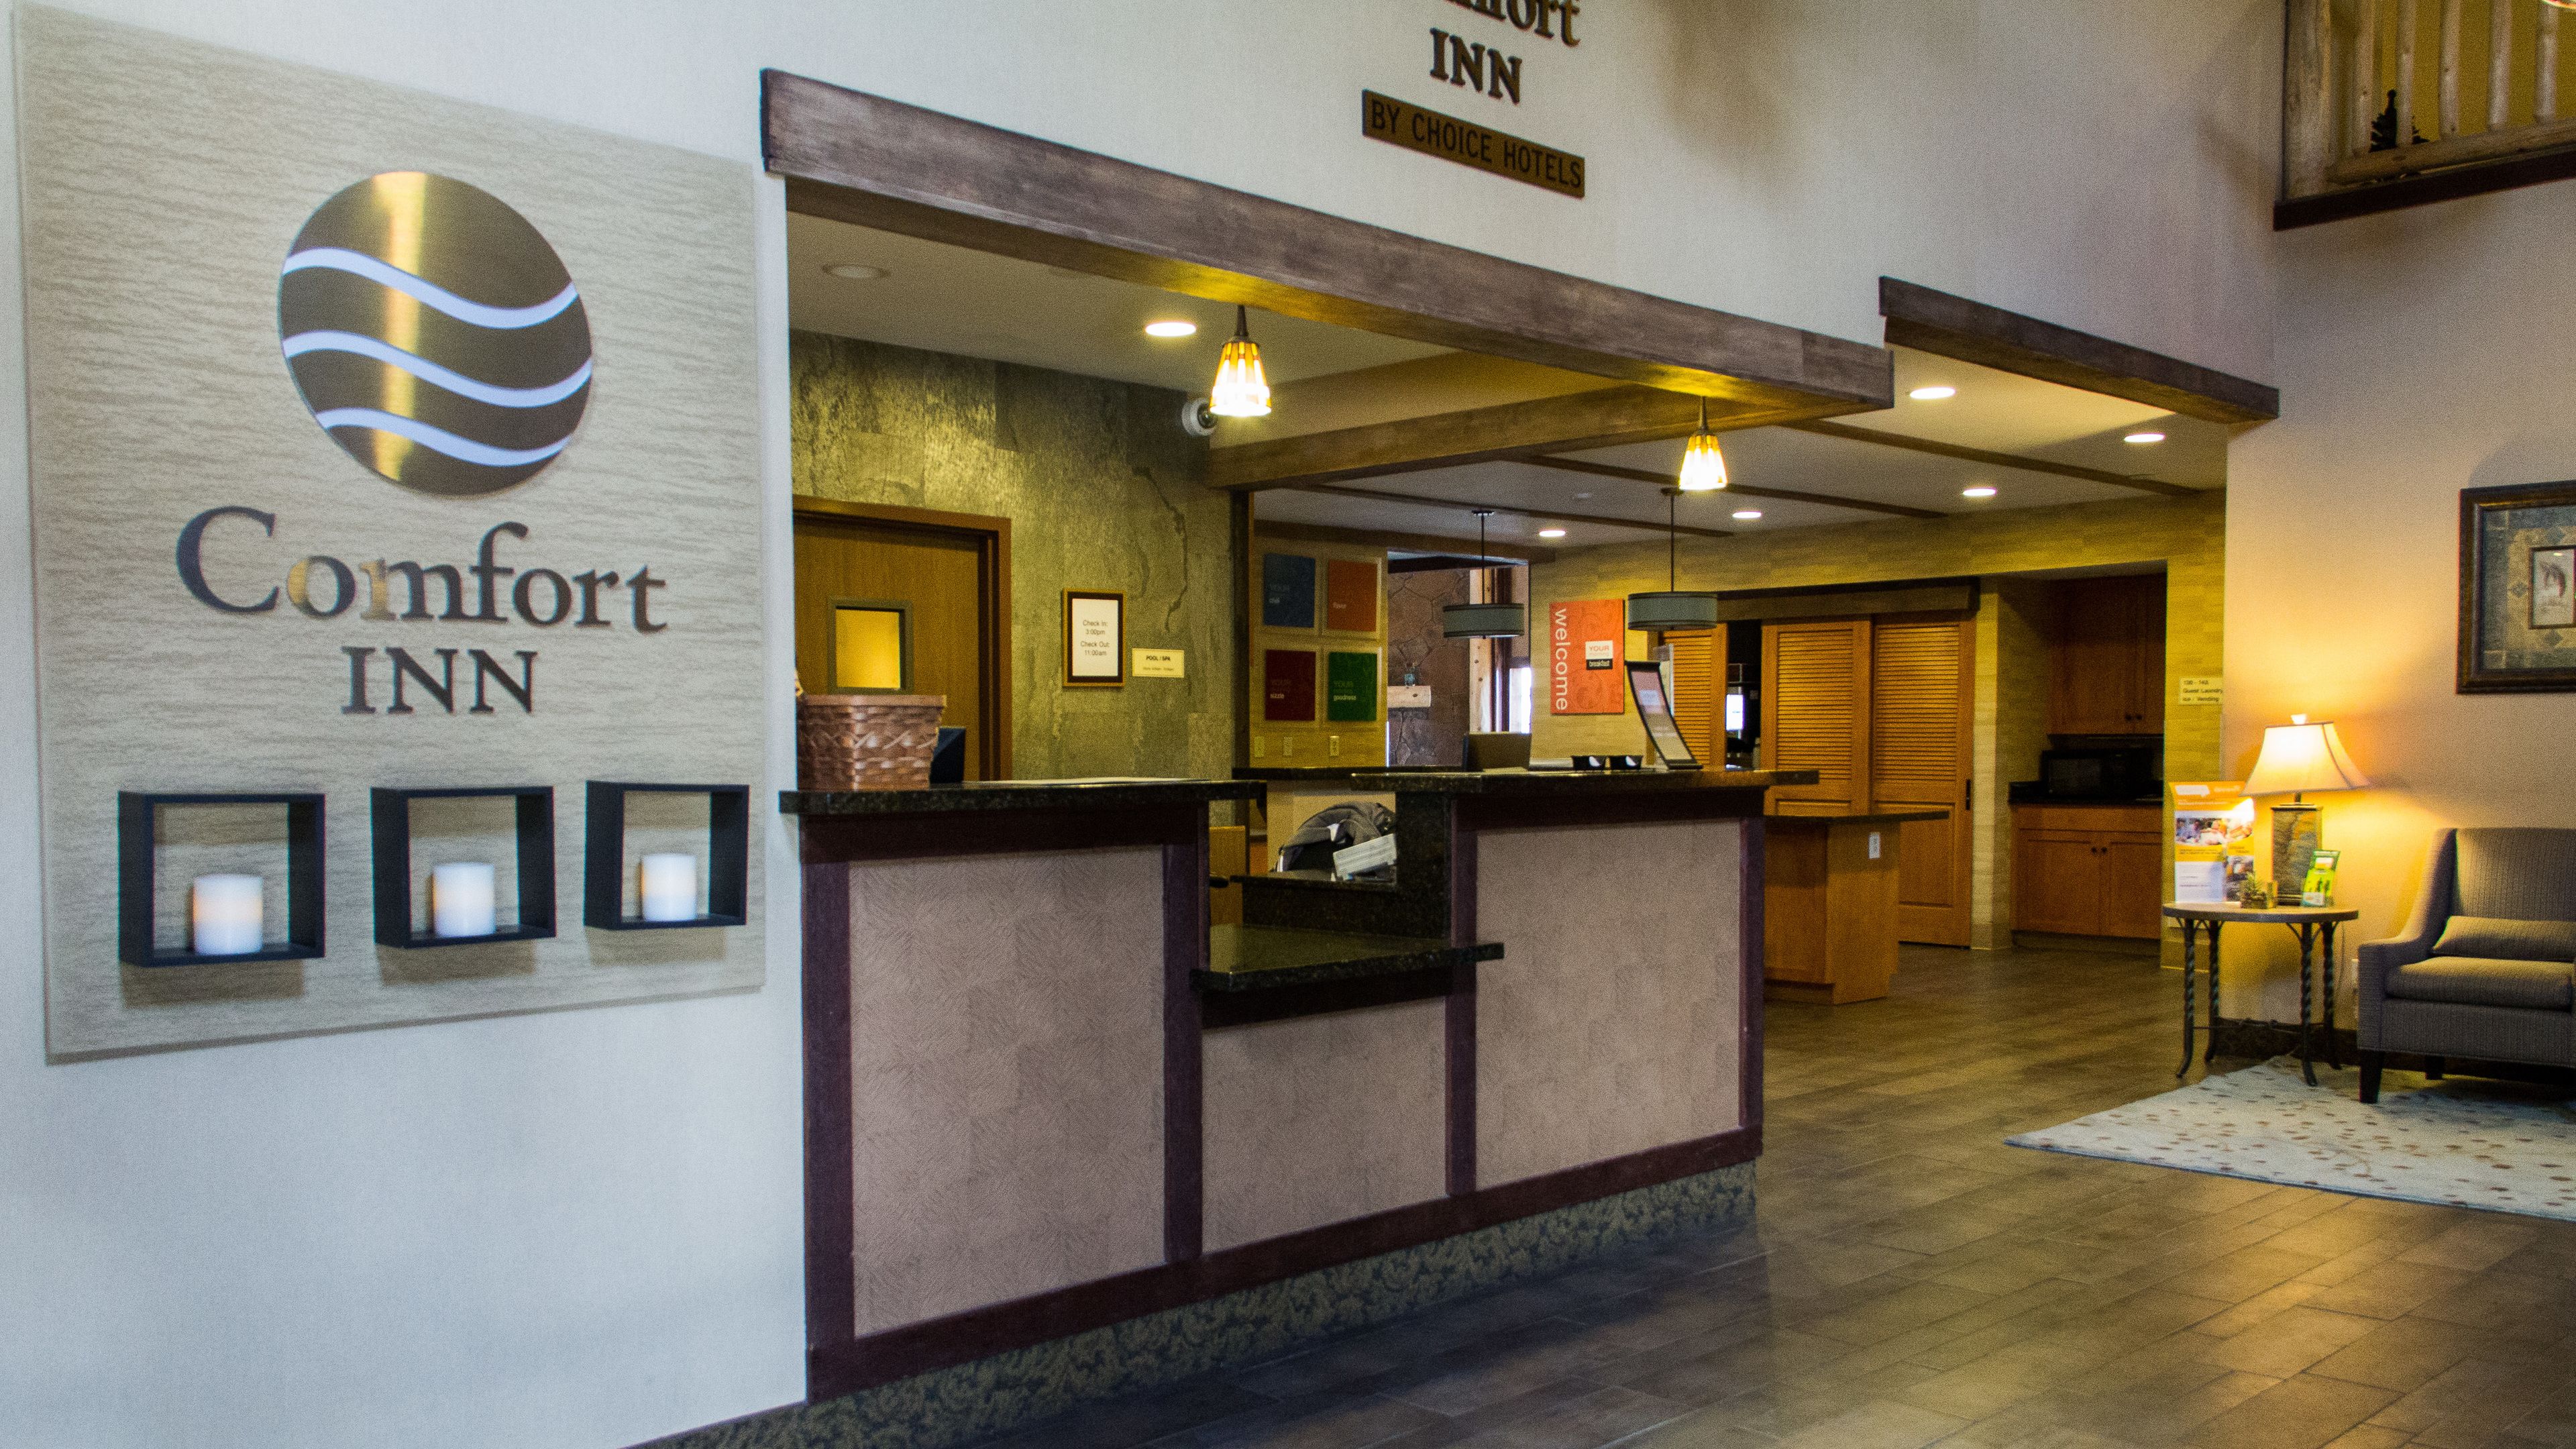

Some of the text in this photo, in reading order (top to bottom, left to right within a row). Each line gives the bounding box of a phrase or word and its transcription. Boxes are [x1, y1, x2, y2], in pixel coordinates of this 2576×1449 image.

[1430, 28, 1522, 105] INN
[1372, 99, 1582, 189] BY CHOICE HOTELS
[175, 505, 668, 633] Comfort
[341, 646, 539, 714] INN
[1554, 608, 1570, 710] welcome
